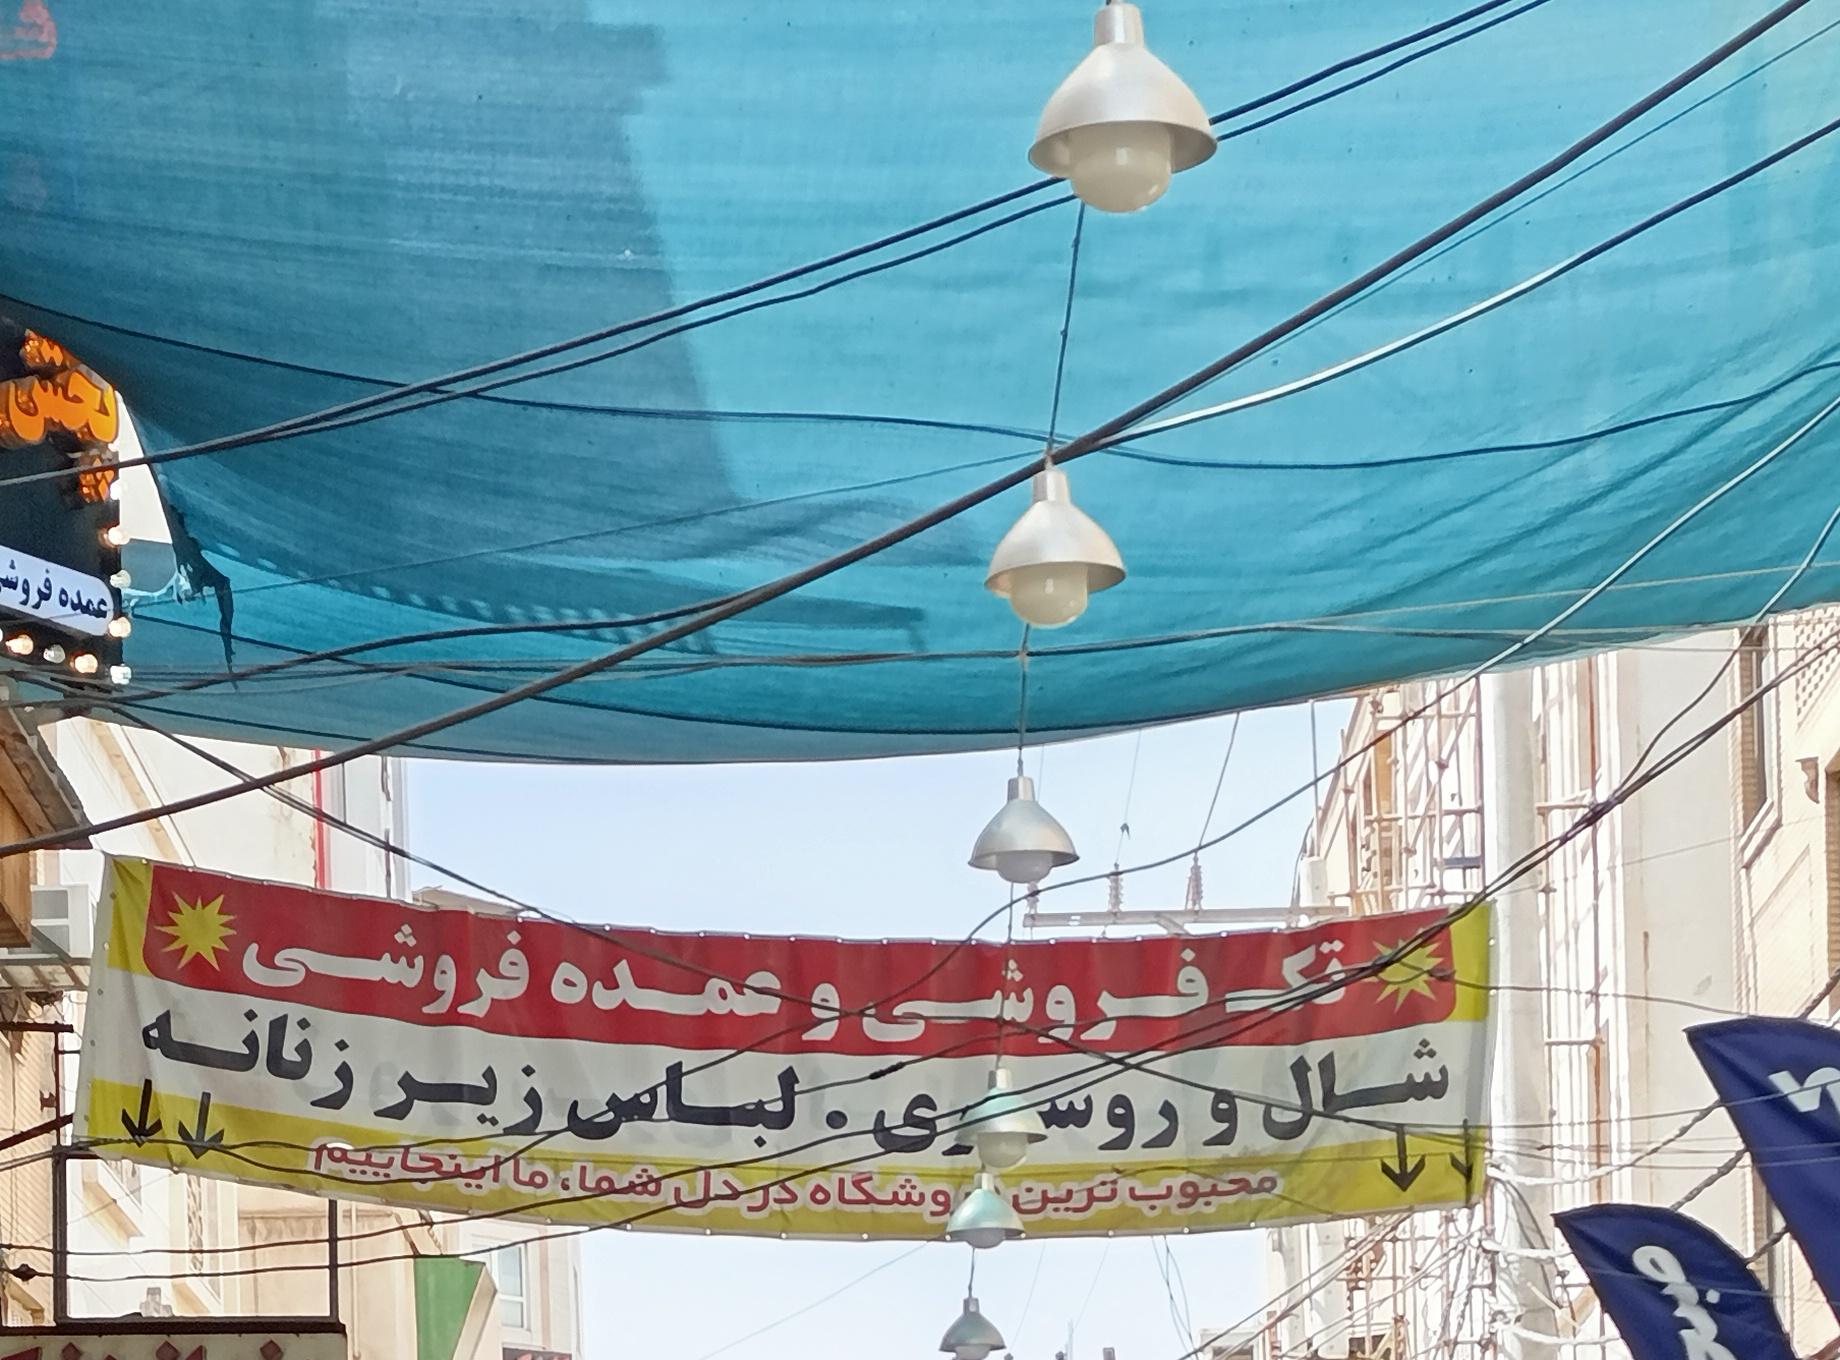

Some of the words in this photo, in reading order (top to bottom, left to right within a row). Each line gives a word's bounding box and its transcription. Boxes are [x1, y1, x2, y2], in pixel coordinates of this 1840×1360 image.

[0, 559, 53, 607] فروش
[59, 588, 109, 619] عمده
[242, 922, 530, 1019] فروشی
[549, 957, 783, 1017] عمده
[862, 946, 1211, 1043] فروشی
[1225, 938, 1348, 1012] تک
[801, 984, 840, 1043] و
[142, 1007, 354, 1110] زنانه
[374, 1062, 542, 1135] زیر
[568, 1060, 799, 1148] لباس
[1202, 1089, 1232, 1146] و
[1262, 1038, 1450, 1140] شال
[313, 1143, 500, 1190] اینجاییم
[513, 1155, 549, 1189] ما
[673, 1168, 744, 1209] دل
[1128, 1172, 1278, 1212] محبوب
[746, 1181, 799, 1213] در
[1011, 1177, 1119, 1215] ترین
